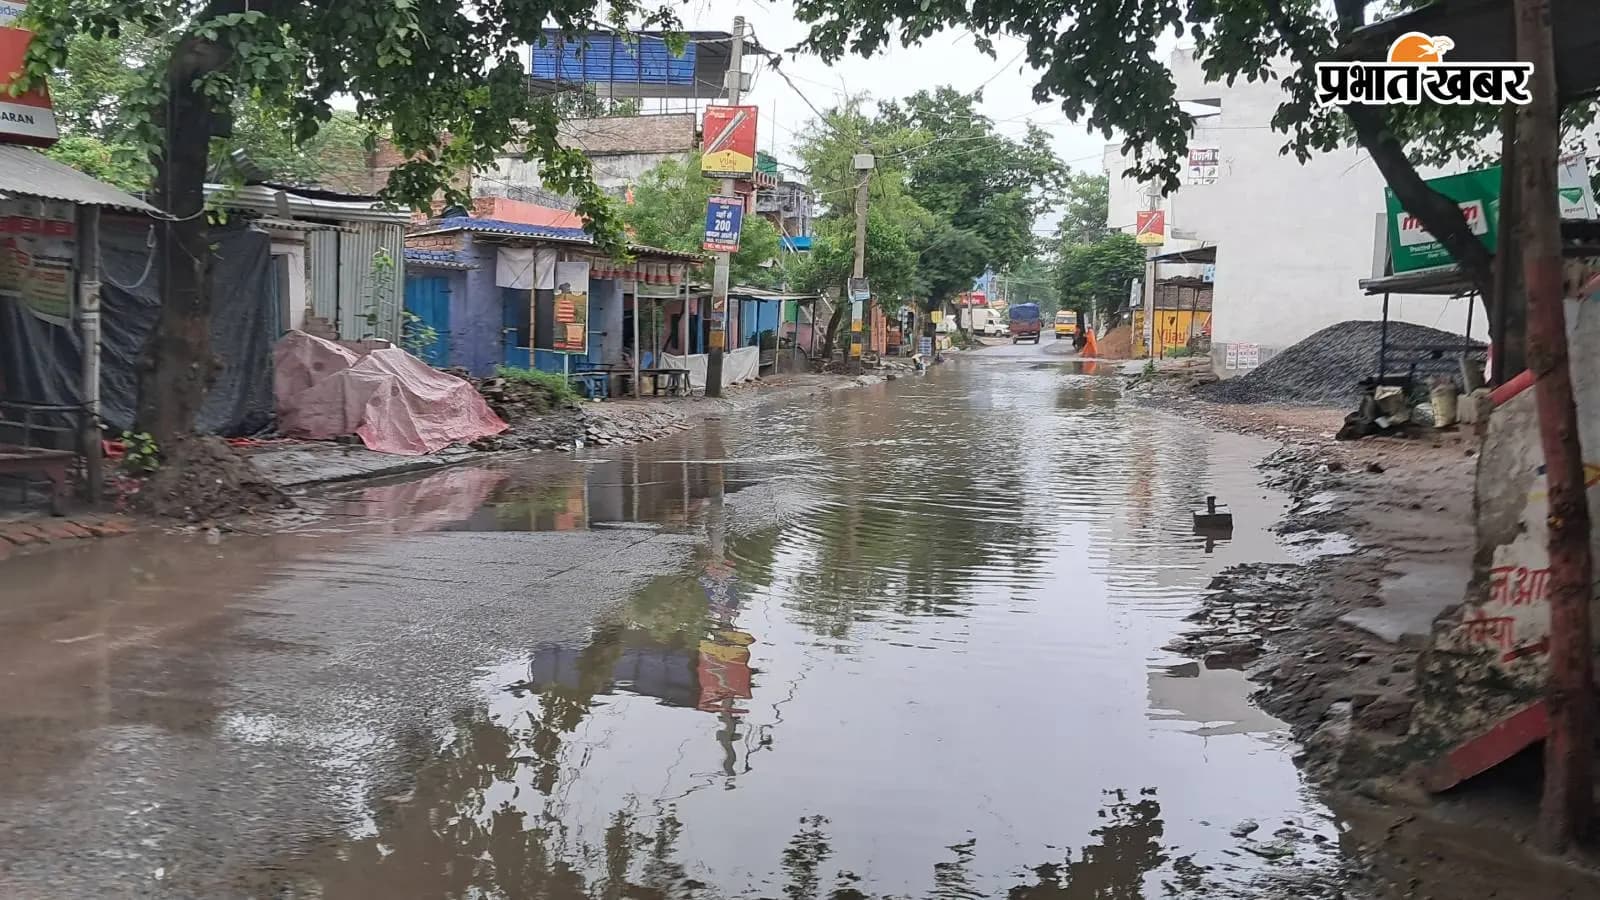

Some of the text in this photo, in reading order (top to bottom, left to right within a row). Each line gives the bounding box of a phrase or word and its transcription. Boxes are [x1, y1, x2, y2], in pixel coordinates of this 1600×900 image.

[0, 111, 34, 125] ARAN
[714, 219, 731, 232] 200
[1157, 327, 1186, 345] Vijay
